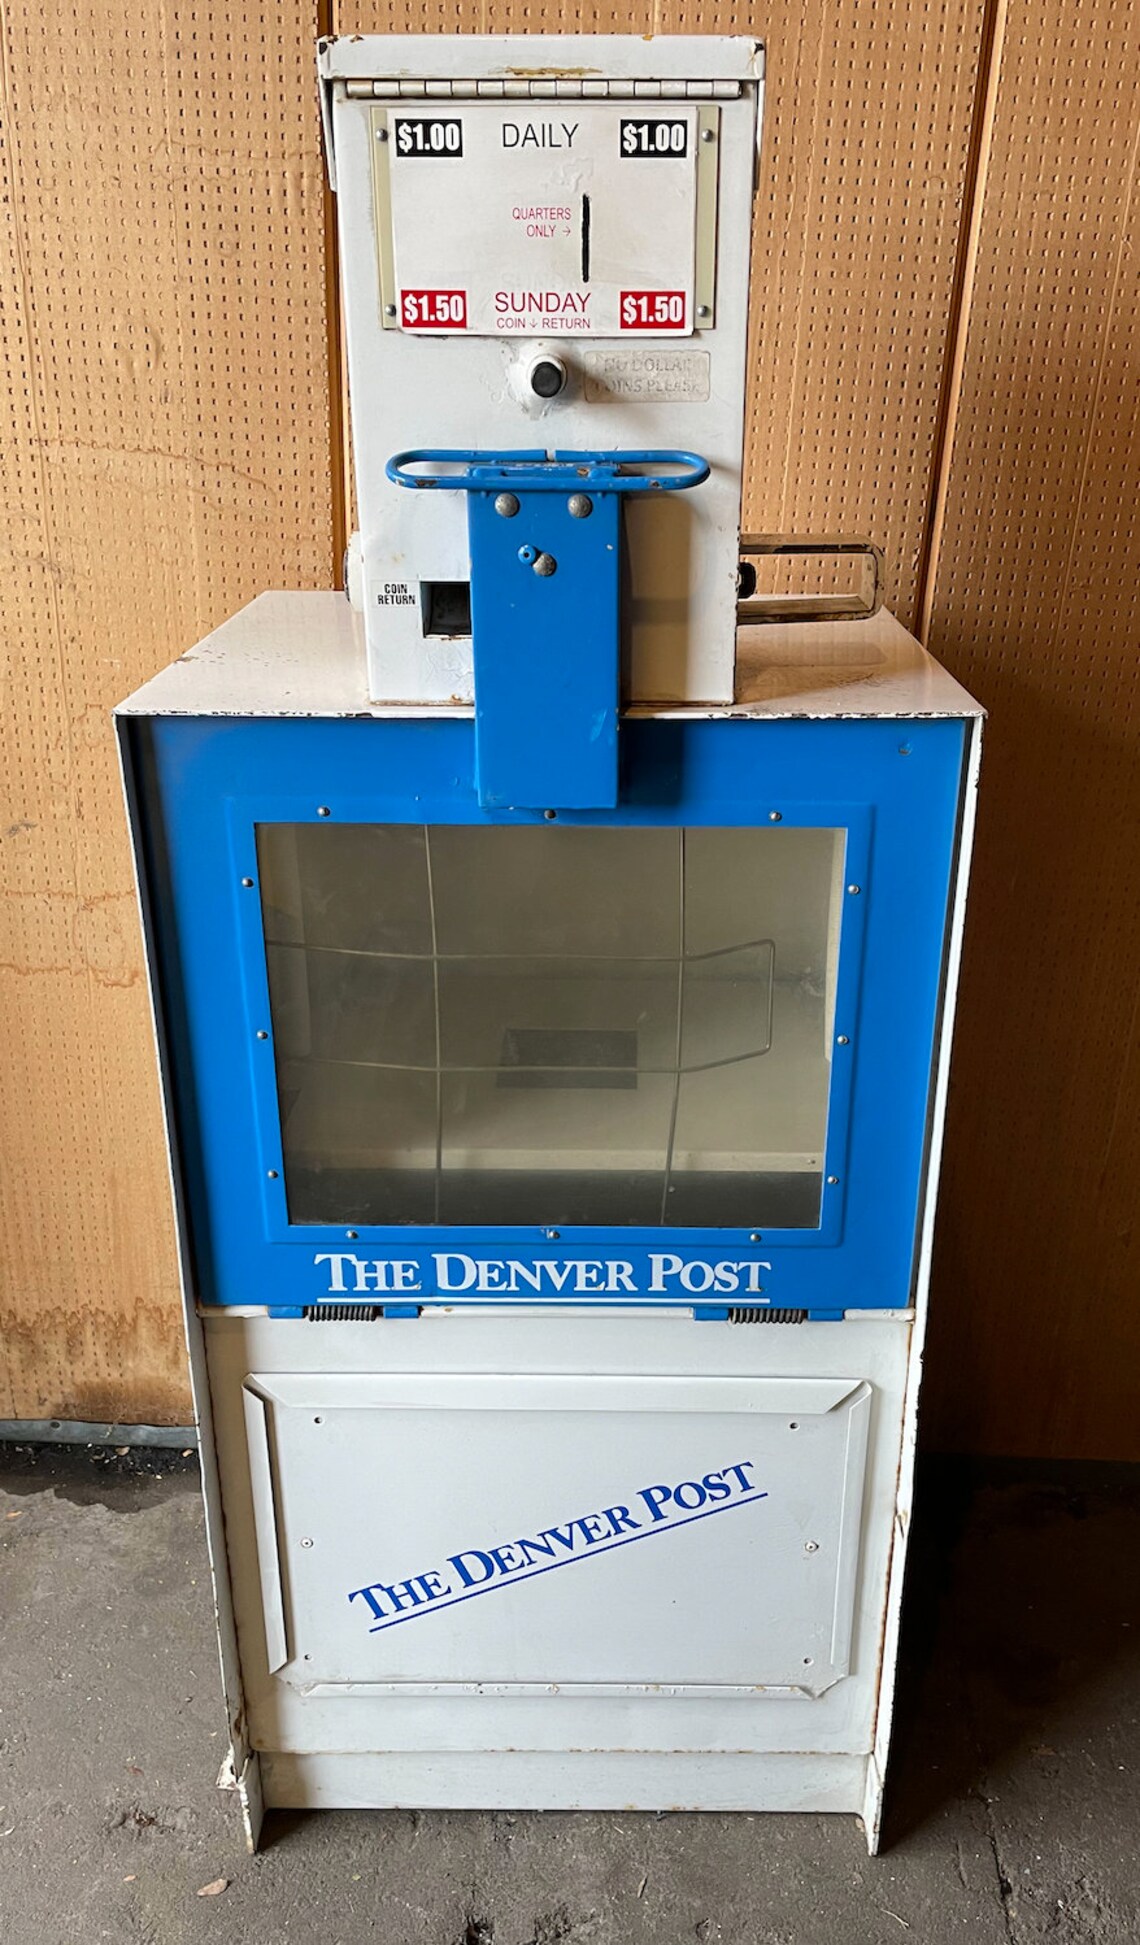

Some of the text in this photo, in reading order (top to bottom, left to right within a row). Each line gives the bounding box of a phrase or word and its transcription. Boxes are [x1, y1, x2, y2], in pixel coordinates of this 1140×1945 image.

[398, 123, 461, 153] $1.00
[502, 123, 579, 147] DAILY
[622, 123, 686, 153] $1.00
[512, 207, 572, 220] QUARTERS
[526, 224, 555, 237] ONLY
[404, 293, 465, 324] $1.50
[495, 291, 592, 313] SUNDAY
[622, 294, 684, 324] $1.50
[496, 317, 591, 329] COIN RETURN
[377, 594, 416, 605] RETURN
[384, 583, 408, 594] COIN
[314, 1253, 771, 1292] THE DENVER POST
[348, 1461, 755, 1620] THE DENVER POST
